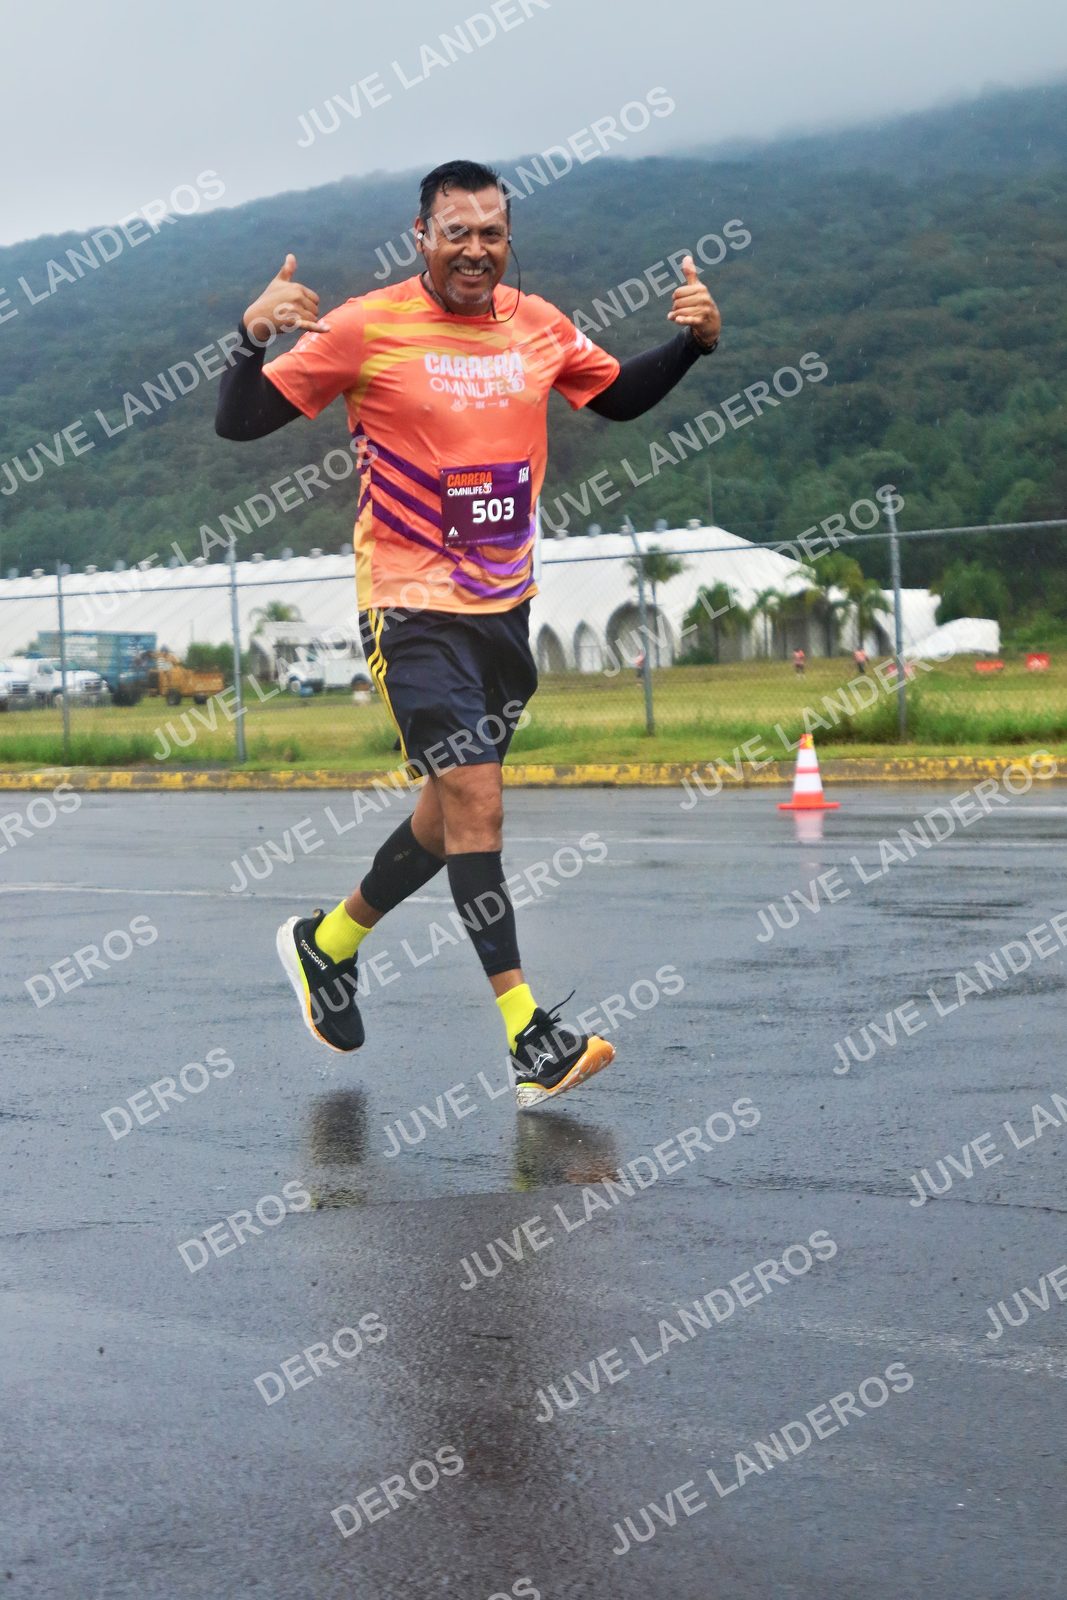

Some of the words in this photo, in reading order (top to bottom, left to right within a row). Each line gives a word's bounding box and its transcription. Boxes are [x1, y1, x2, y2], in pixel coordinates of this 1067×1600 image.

[424, 352, 523, 378] CARRERA
[429, 377, 507, 399] OMNILIFE
[447, 471, 493, 488] CARRERA
[447, 485, 483, 496] OMNILIFE
[472, 496, 515, 523] 503
[300, 939, 328, 971] saucony
